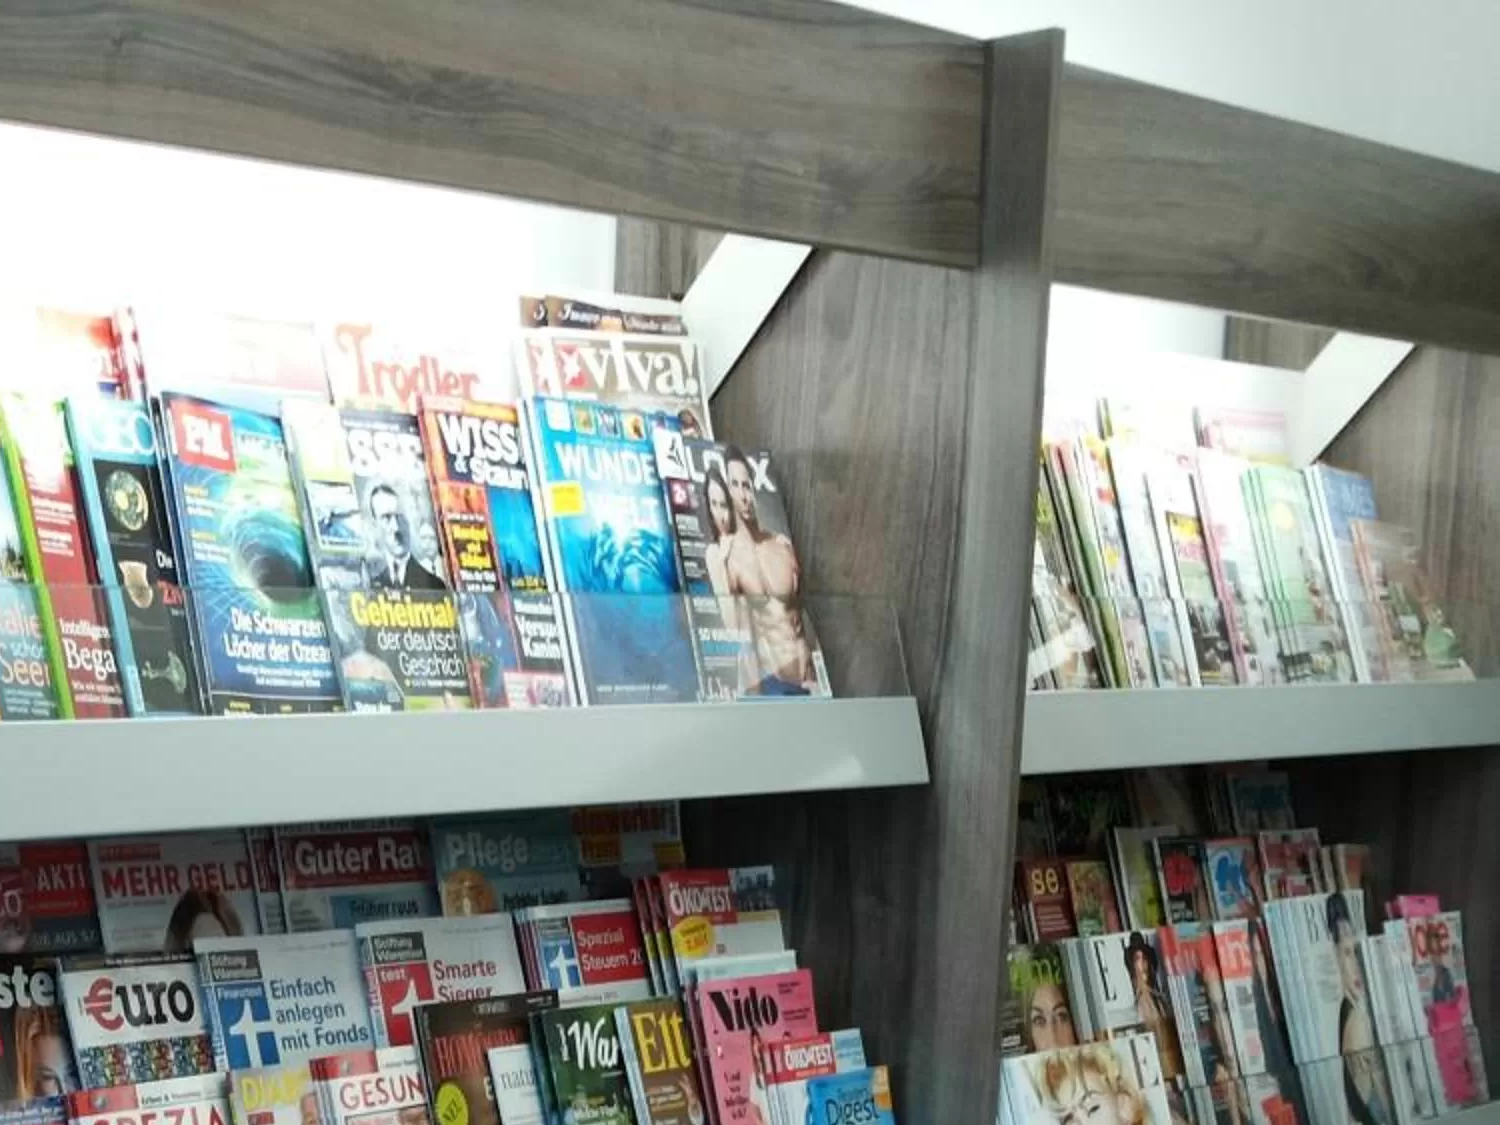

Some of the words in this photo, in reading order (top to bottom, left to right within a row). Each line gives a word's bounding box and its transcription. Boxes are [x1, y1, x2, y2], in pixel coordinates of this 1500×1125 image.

[377, 629, 402, 648] der
[295, 839, 370, 875] Guter
[446, 833, 528, 869] Pflege
[102, 865, 180, 899] MEHR
[432, 960, 497, 981] Smarte
[269, 977, 336, 999] Einfach
[274, 1005, 346, 1027] anlegen
[708, 986, 780, 1033] Nido
[281, 1030, 310, 1051] mit
[314, 1026, 369, 1047] Fonds
